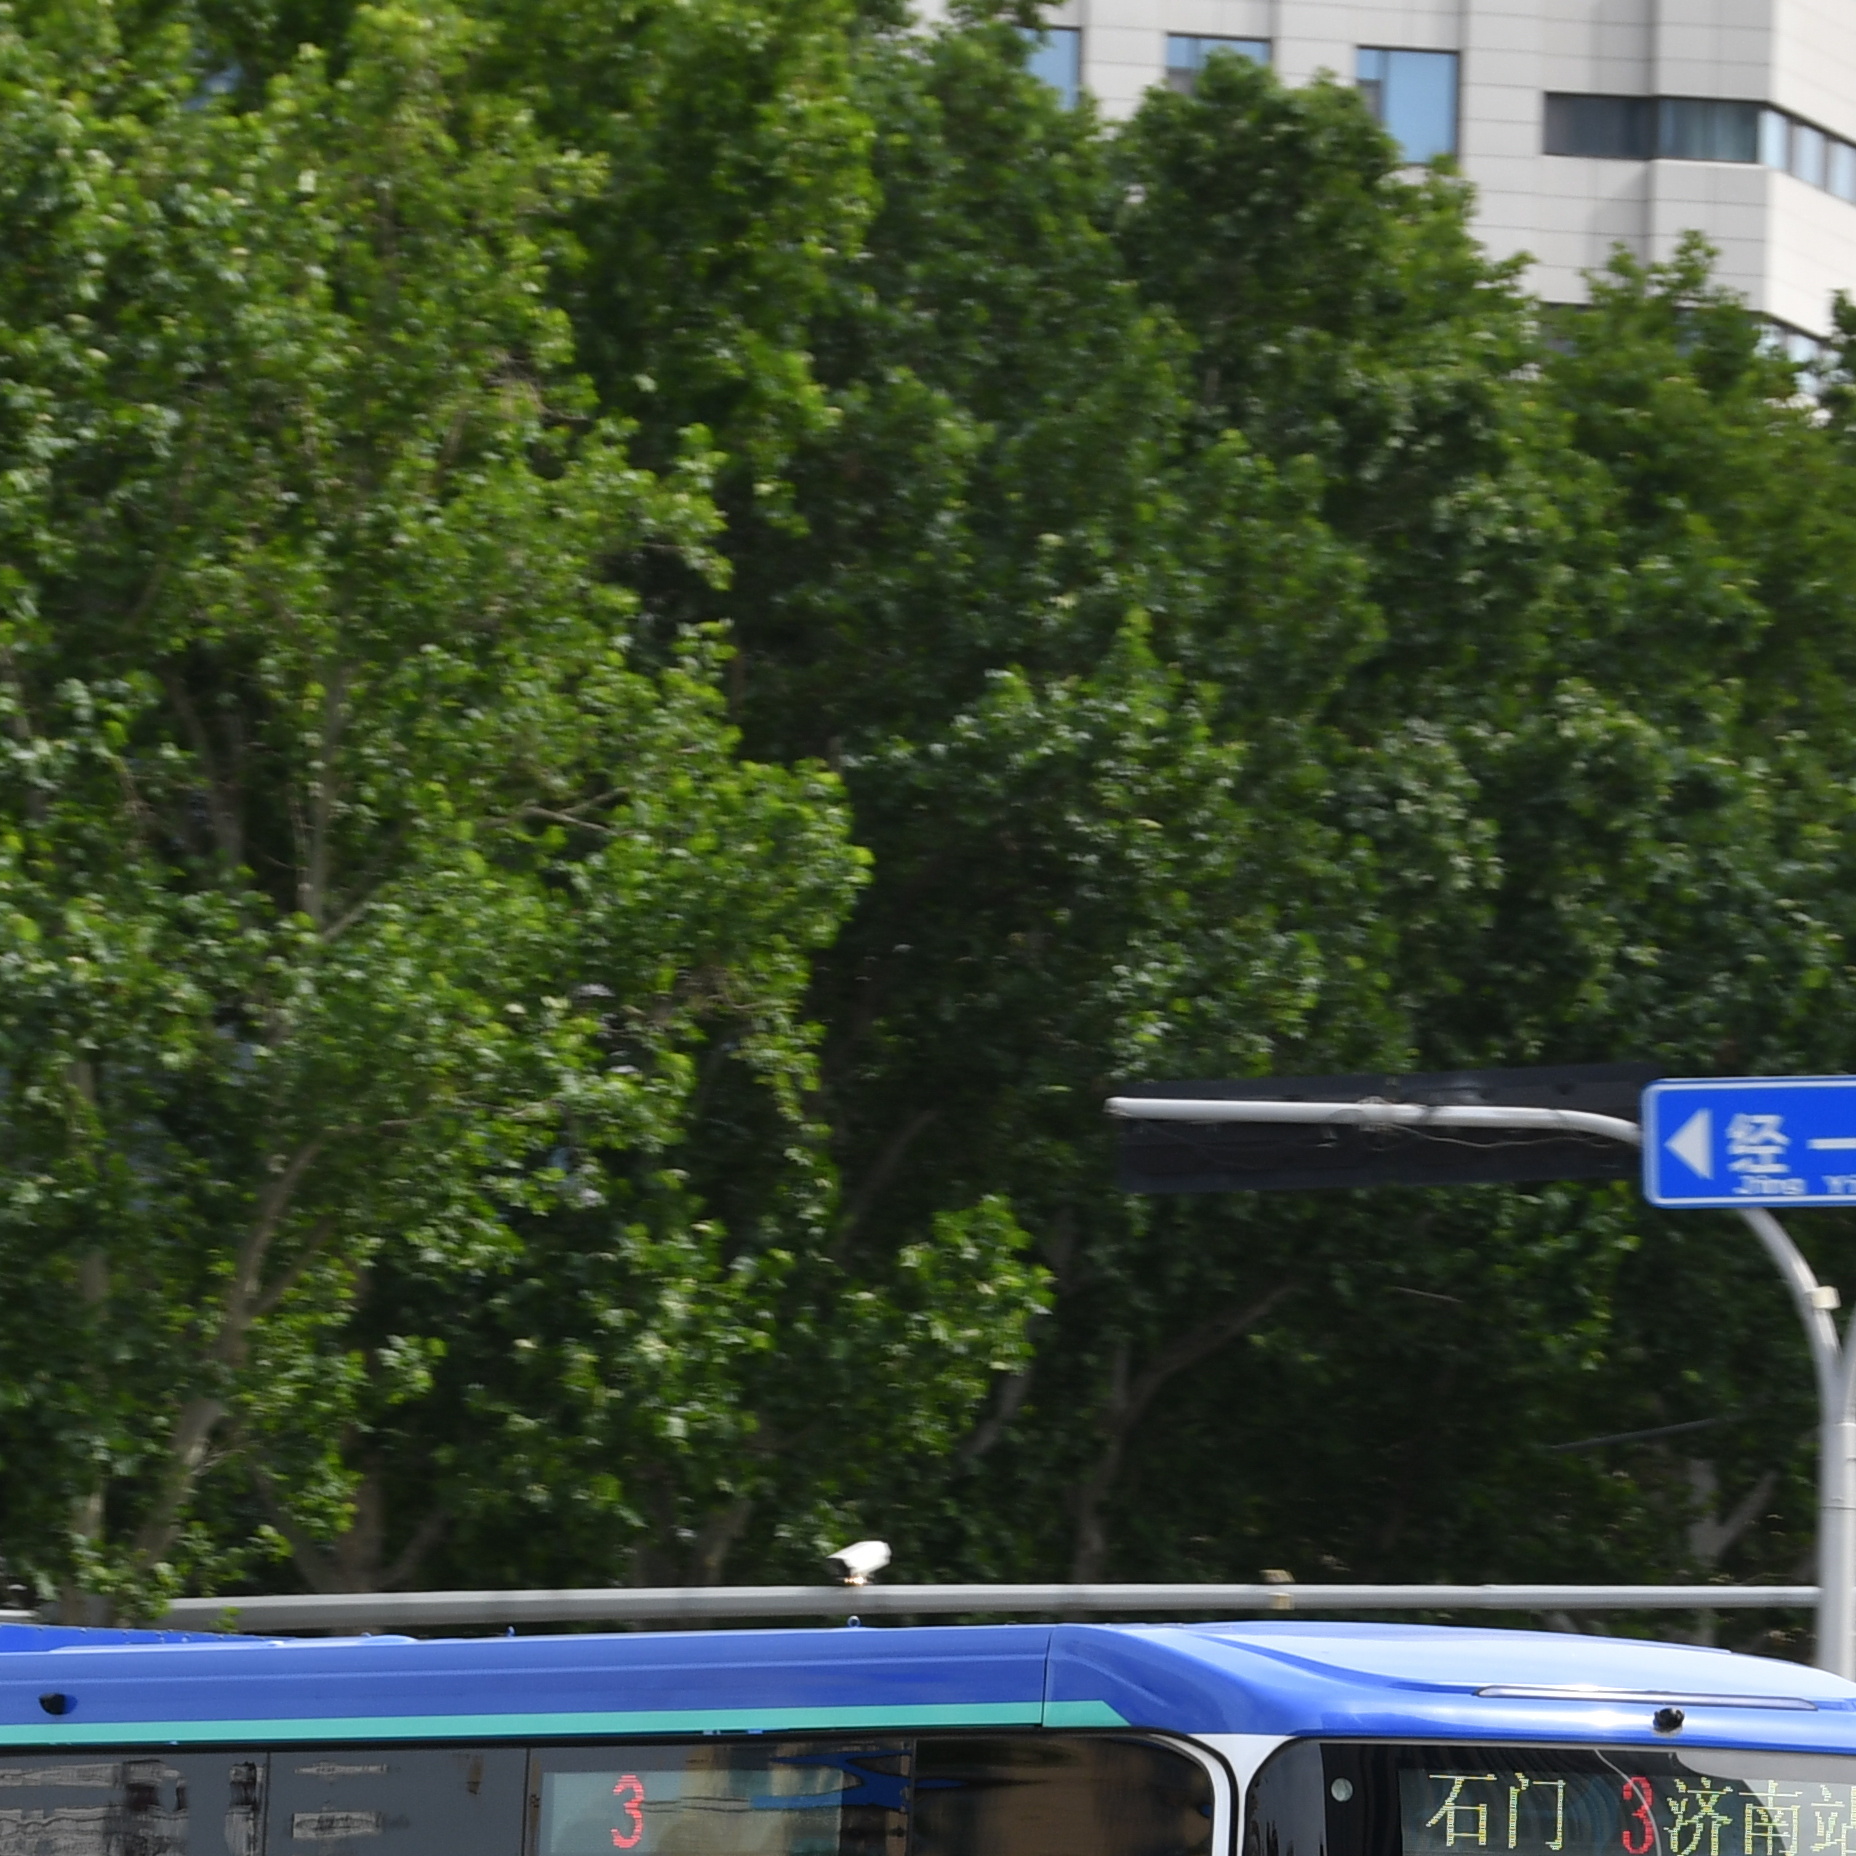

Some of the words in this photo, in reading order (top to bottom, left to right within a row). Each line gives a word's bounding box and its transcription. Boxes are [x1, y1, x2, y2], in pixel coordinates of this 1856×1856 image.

[1732, 1174, 1806, 1195] Jing
[610, 1774, 644, 1848] 3
[1426, 1773, 1566, 1850] 石门
[1622, 1776, 1653, 1855] 3
